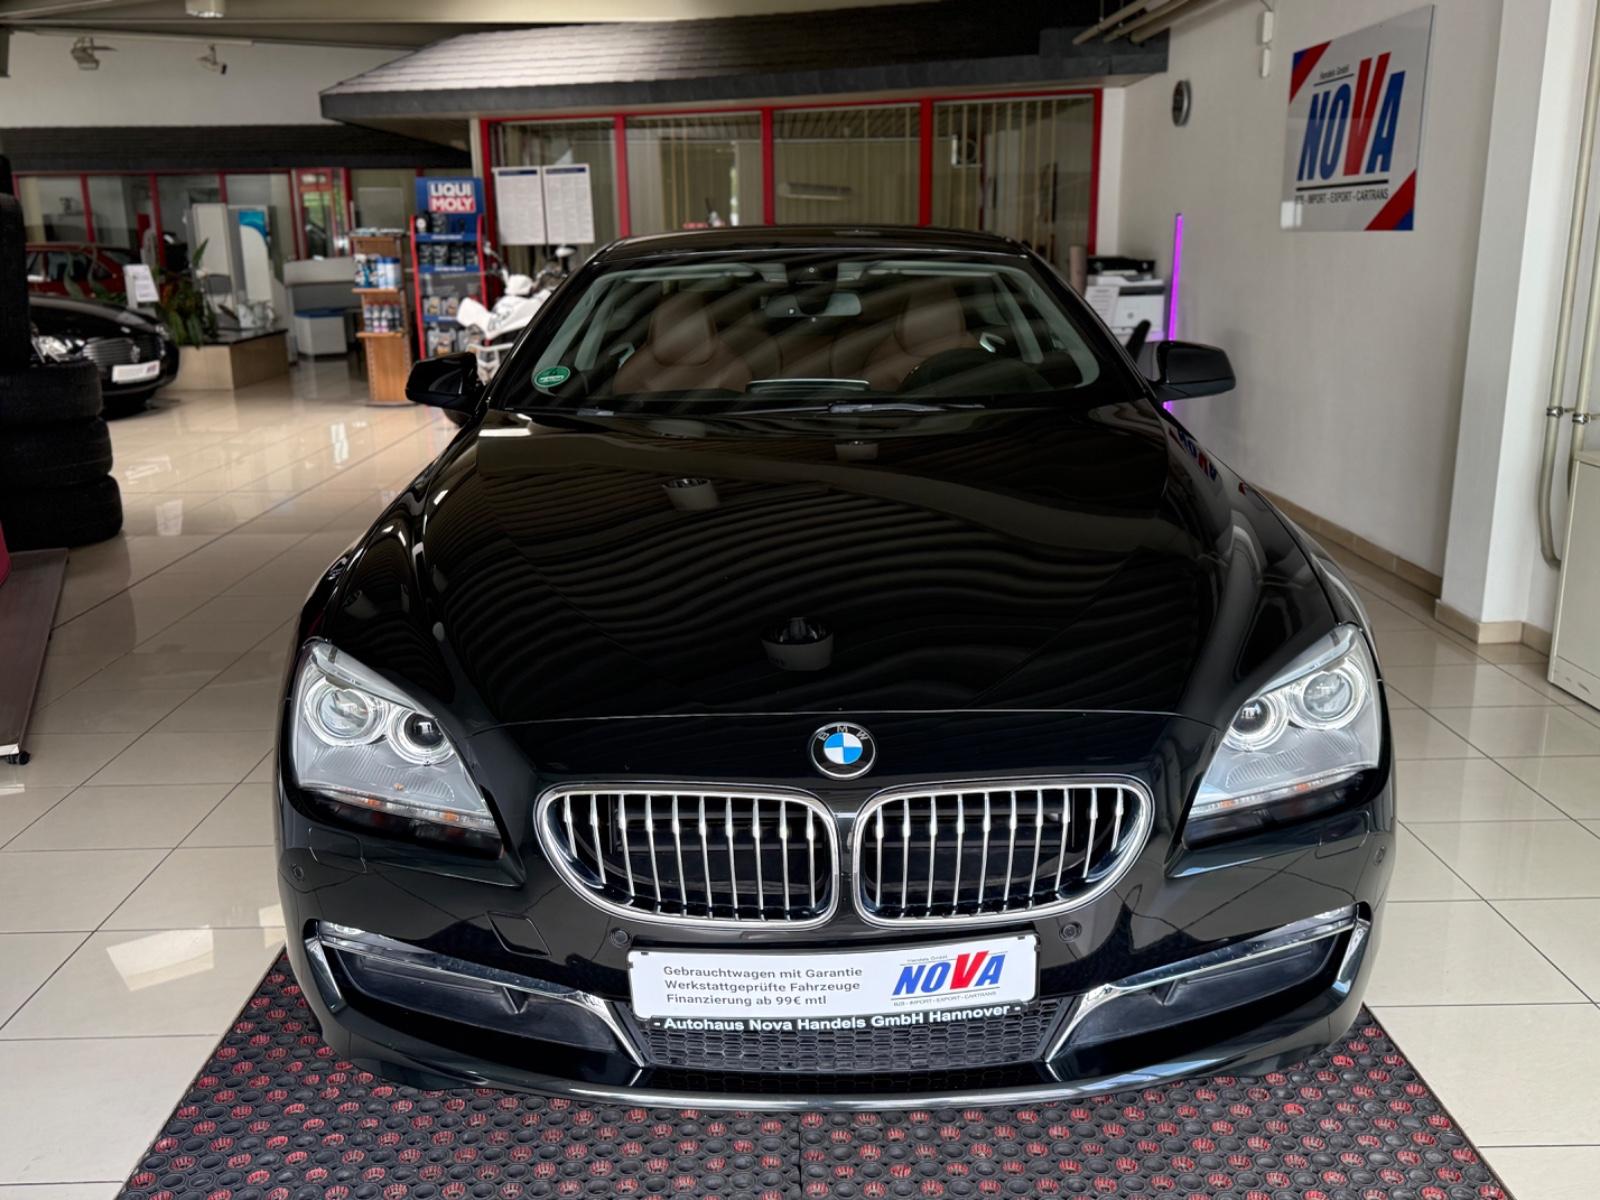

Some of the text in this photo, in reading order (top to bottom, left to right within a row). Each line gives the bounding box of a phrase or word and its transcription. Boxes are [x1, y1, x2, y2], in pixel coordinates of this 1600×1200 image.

[1296, 51, 1406, 182] NOVA
[430, 182, 472, 197] LIQUI
[430, 197, 475, 211] MOLY
[816, 724, 869, 741] BMW
[663, 966, 863, 980] Gebrauchtwagen mit Garantie
[892, 950, 1006, 996] NOVA
[664, 979, 861, 993] Werkstattgeprüfte Fahrzeuge
[666, 994, 827, 1007] Finanzierung ab 99€ mtl
[664, 1018, 745, 1031] Autohaus
[750, 1019, 793, 1031] Nova
[797, 1017, 866, 1031] Handels
[870, 1012, 924, 1027] GmbH
[929, 1004, 1010, 1023] Hannover
